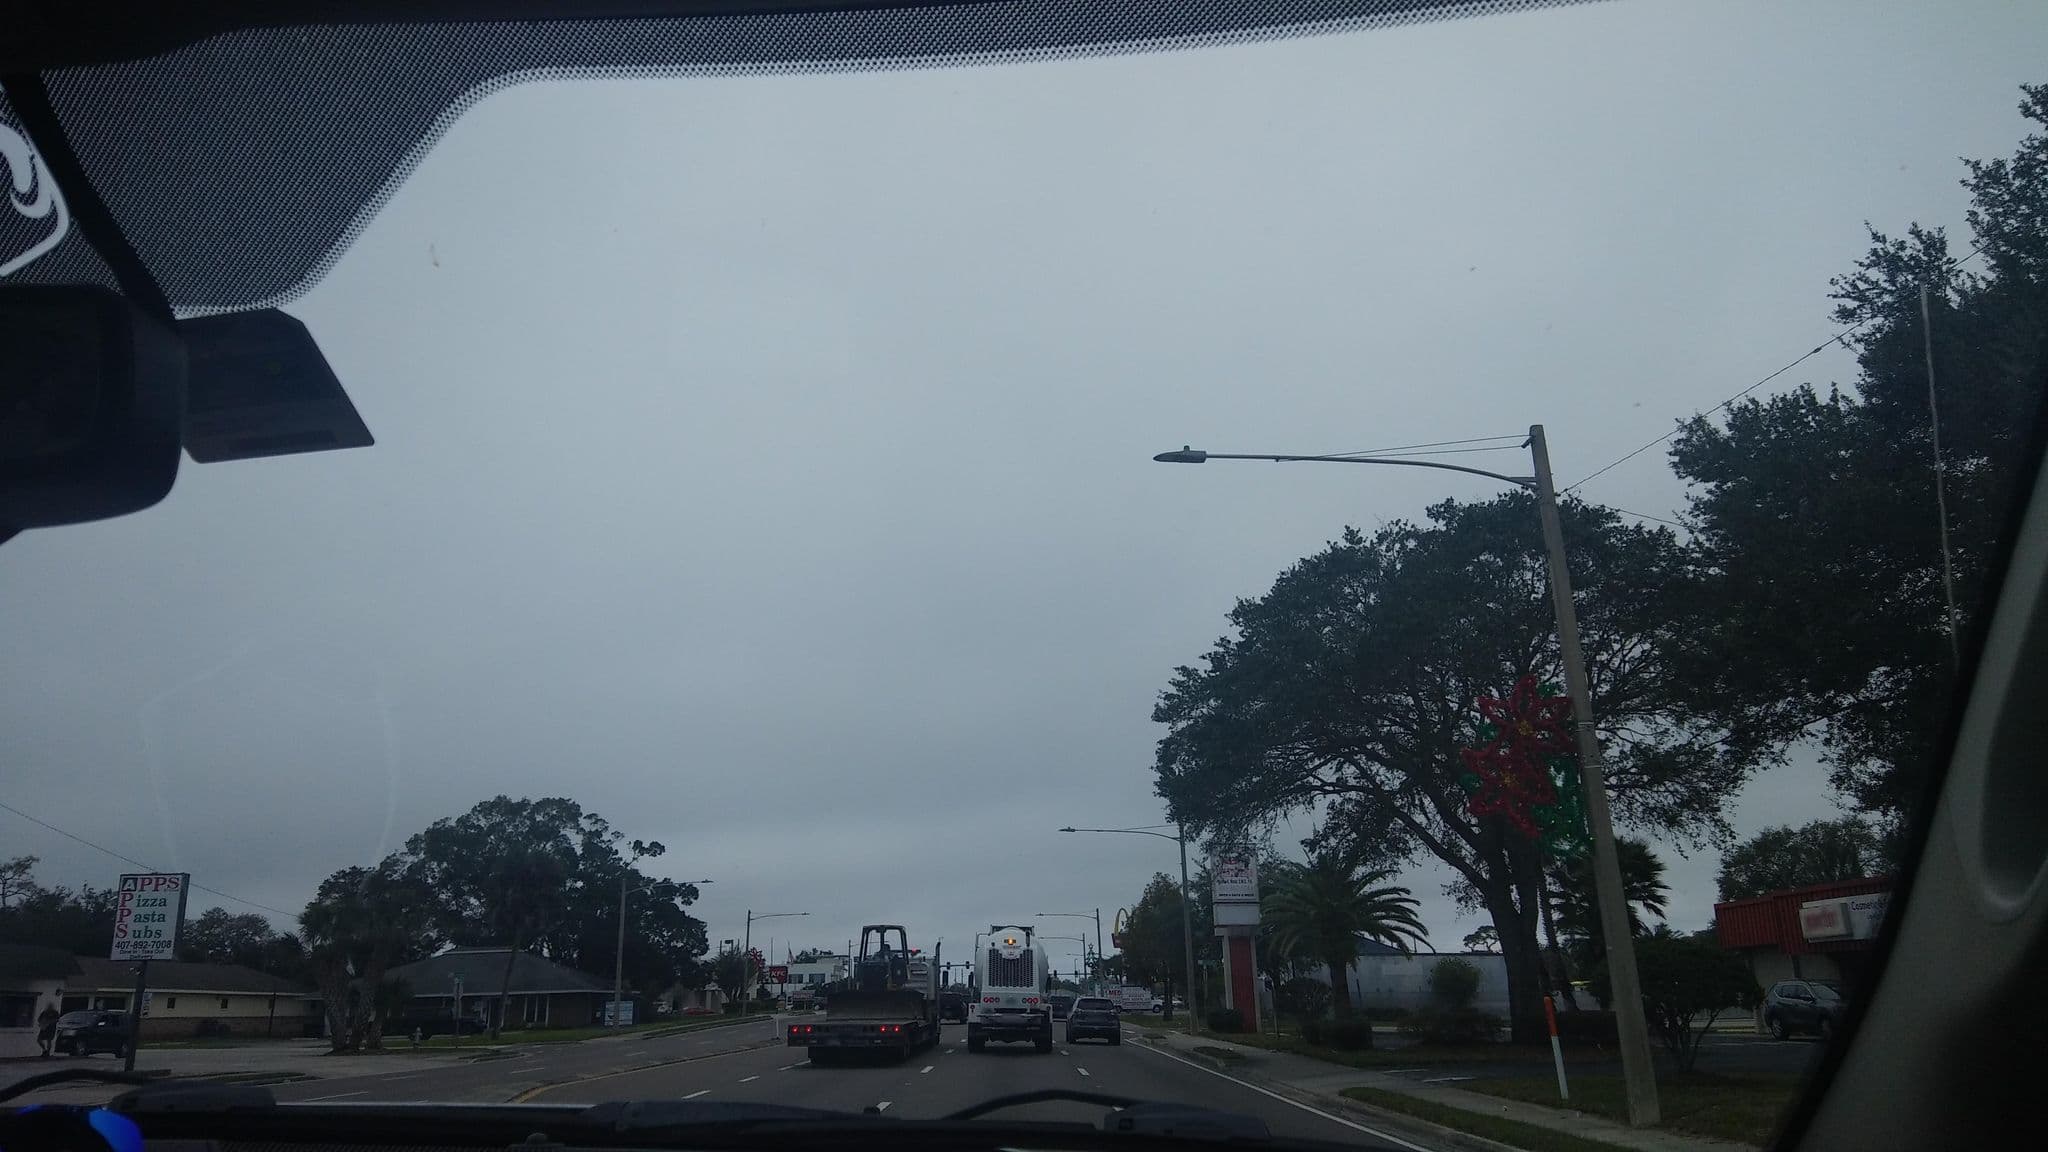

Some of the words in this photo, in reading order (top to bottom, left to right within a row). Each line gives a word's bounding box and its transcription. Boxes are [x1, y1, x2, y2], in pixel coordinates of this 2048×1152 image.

[121, 877, 180, 892] APPS
[119, 892, 167, 907] Pizza
[117, 908, 166, 923] Pasta
[115, 923, 162, 939] Subs
[114, 940, 172, 949] 407-892-7008
